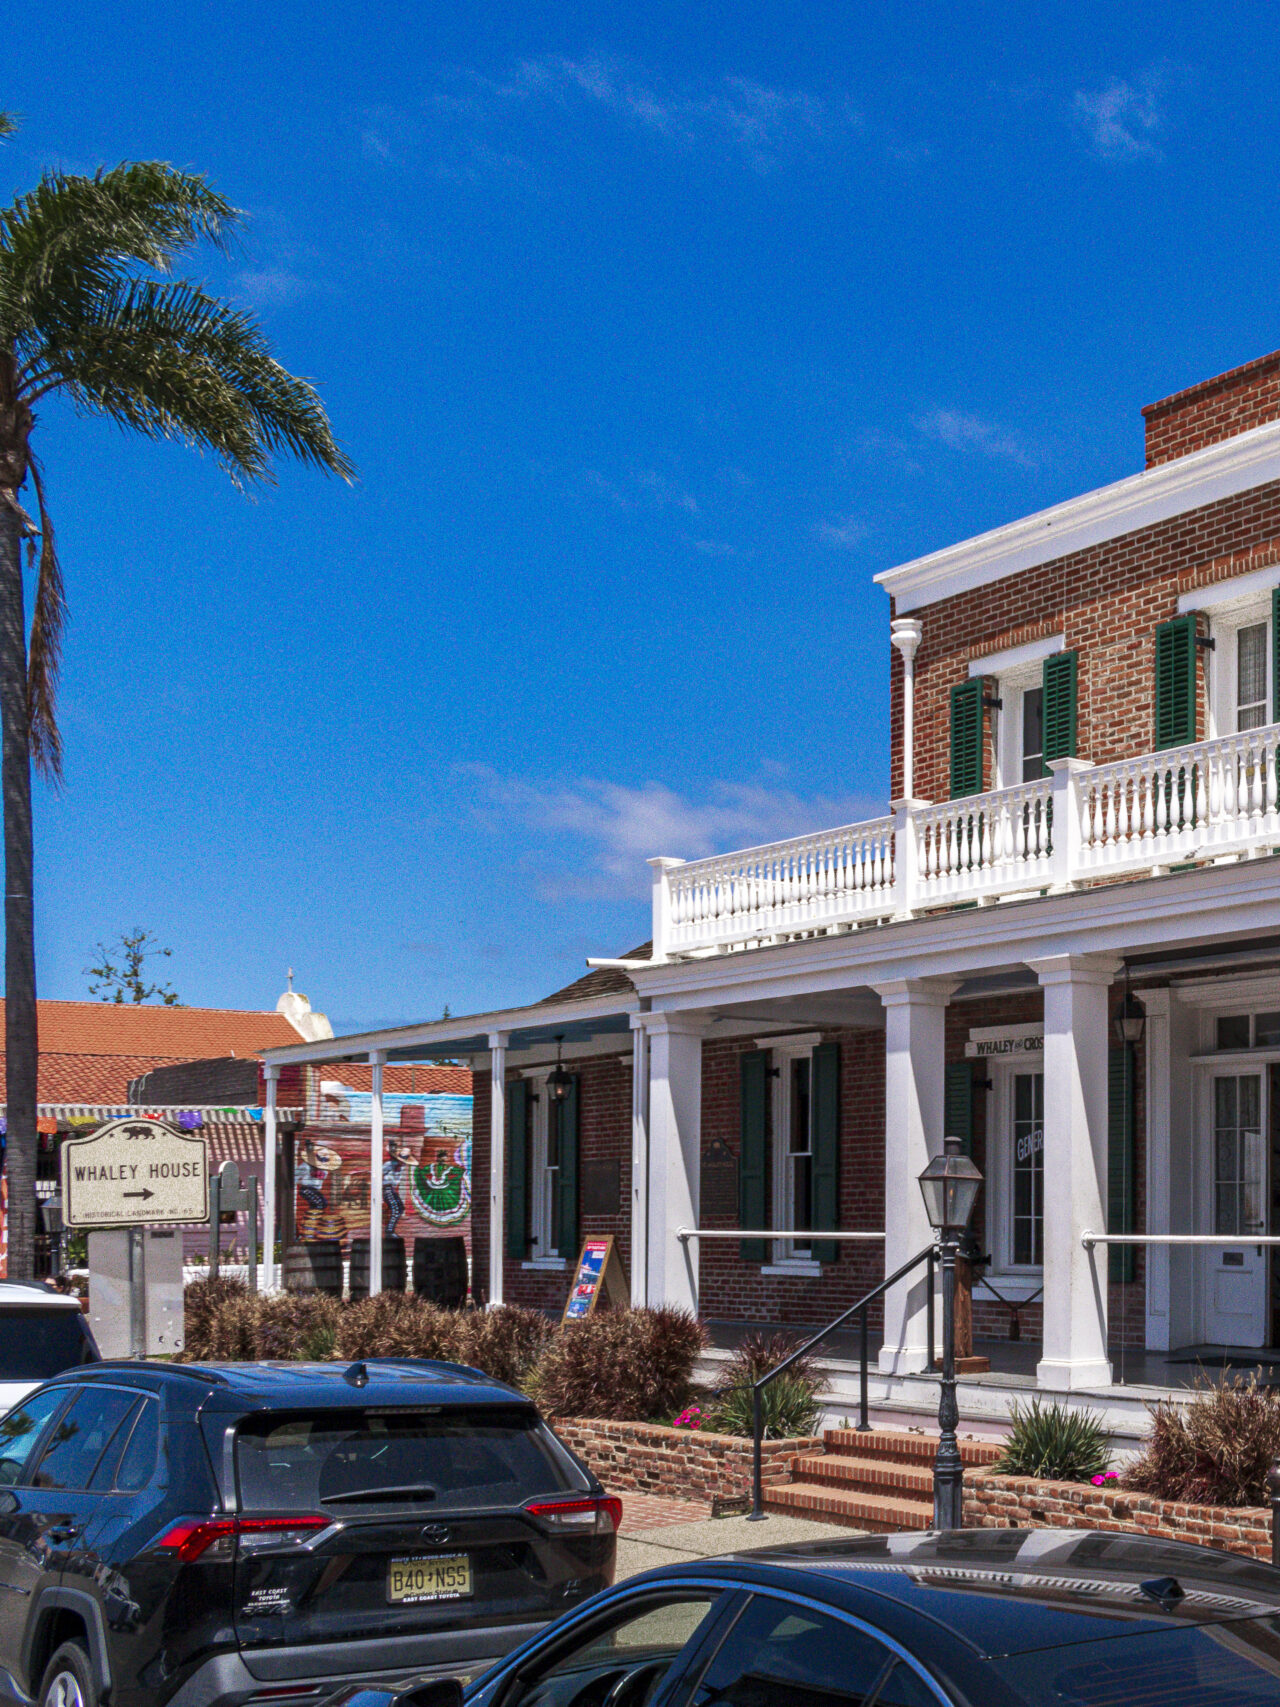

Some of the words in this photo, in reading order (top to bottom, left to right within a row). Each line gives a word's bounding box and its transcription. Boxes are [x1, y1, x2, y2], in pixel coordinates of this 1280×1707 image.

[977, 1040, 1014, 1055] WHALEY
[75, 1165, 138, 1181] WHALEY
[149, 1162, 201, 1178] HOUSE
[83, 1210, 124, 1219] HISTORICAL
[126, 1208, 164, 1217] LANDMARK
